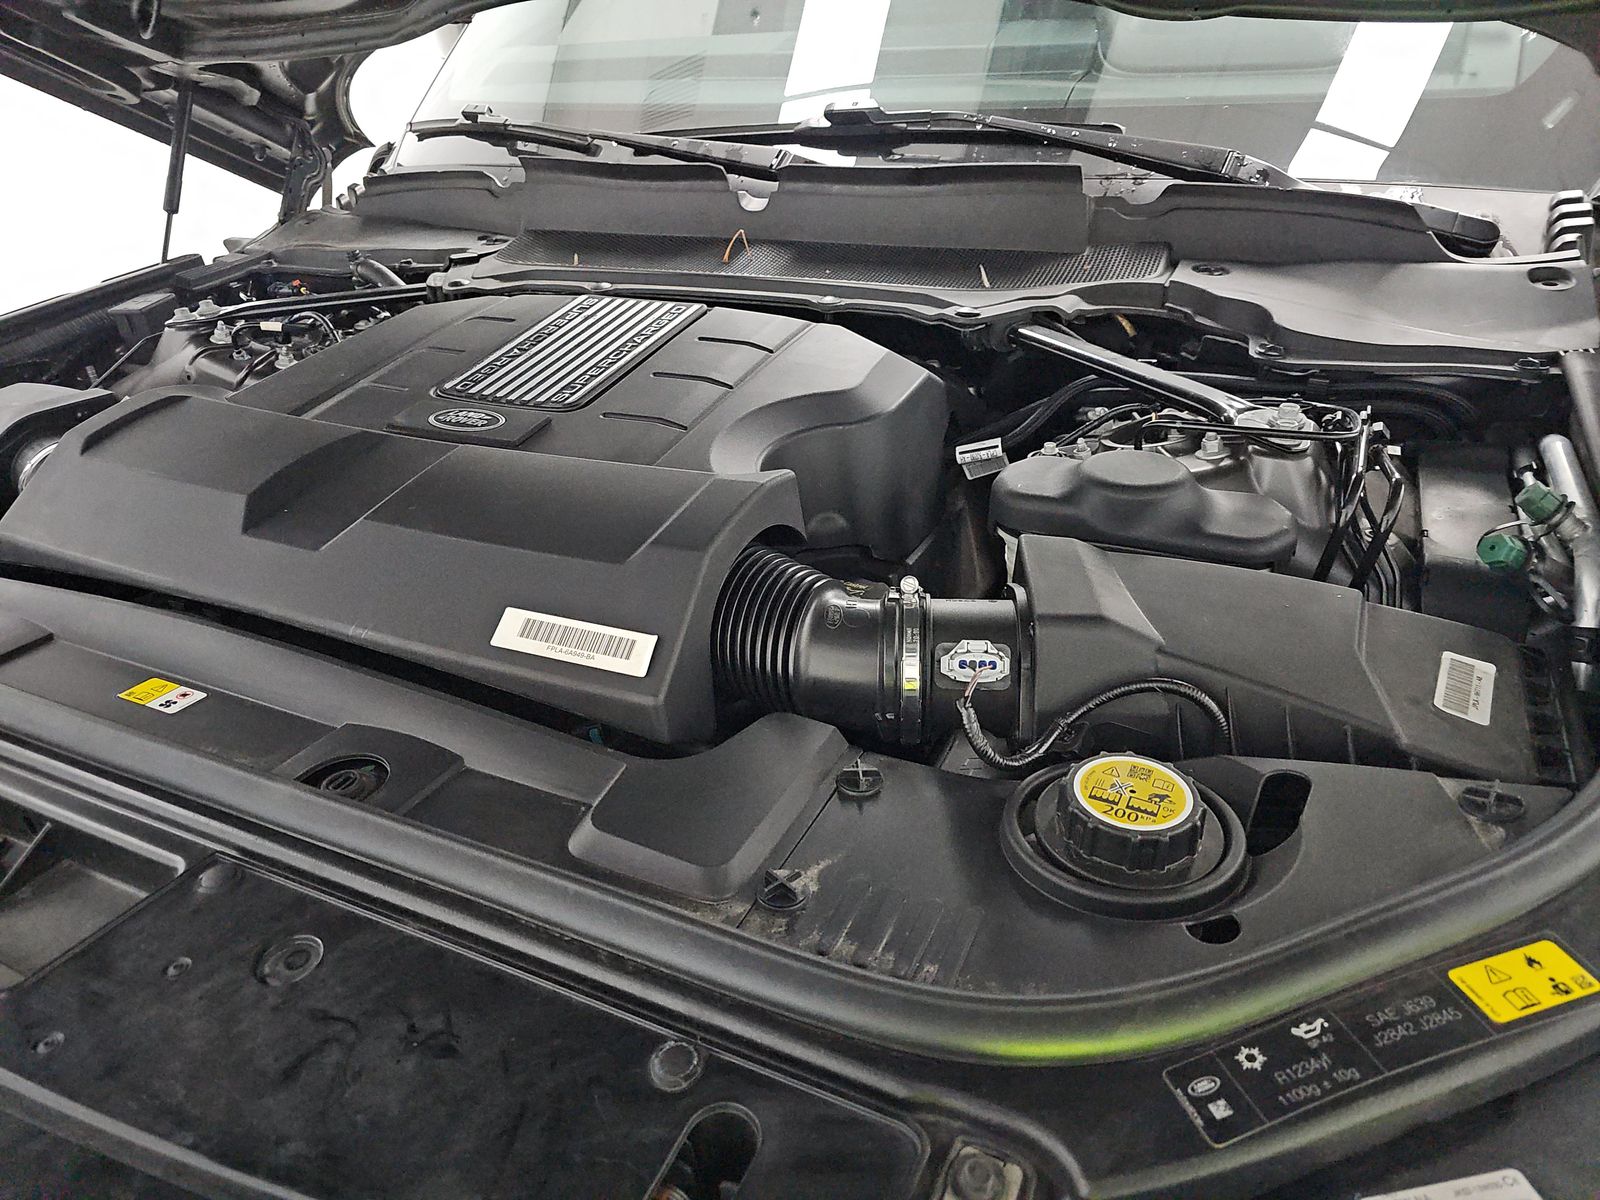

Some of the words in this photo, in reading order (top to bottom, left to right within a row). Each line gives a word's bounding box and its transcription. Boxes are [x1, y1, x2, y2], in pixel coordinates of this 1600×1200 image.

[457, 297, 599, 390] SUPERCHARGED
[553, 304, 687, 402] SUPERCHARGED
[441, 415, 488, 427] ROVER
[447, 410, 486, 419] LAND
[1102, 804, 1139, 822] 200
[1365, 1006, 1400, 1027] SAE
[1402, 995, 1436, 1016] J639
